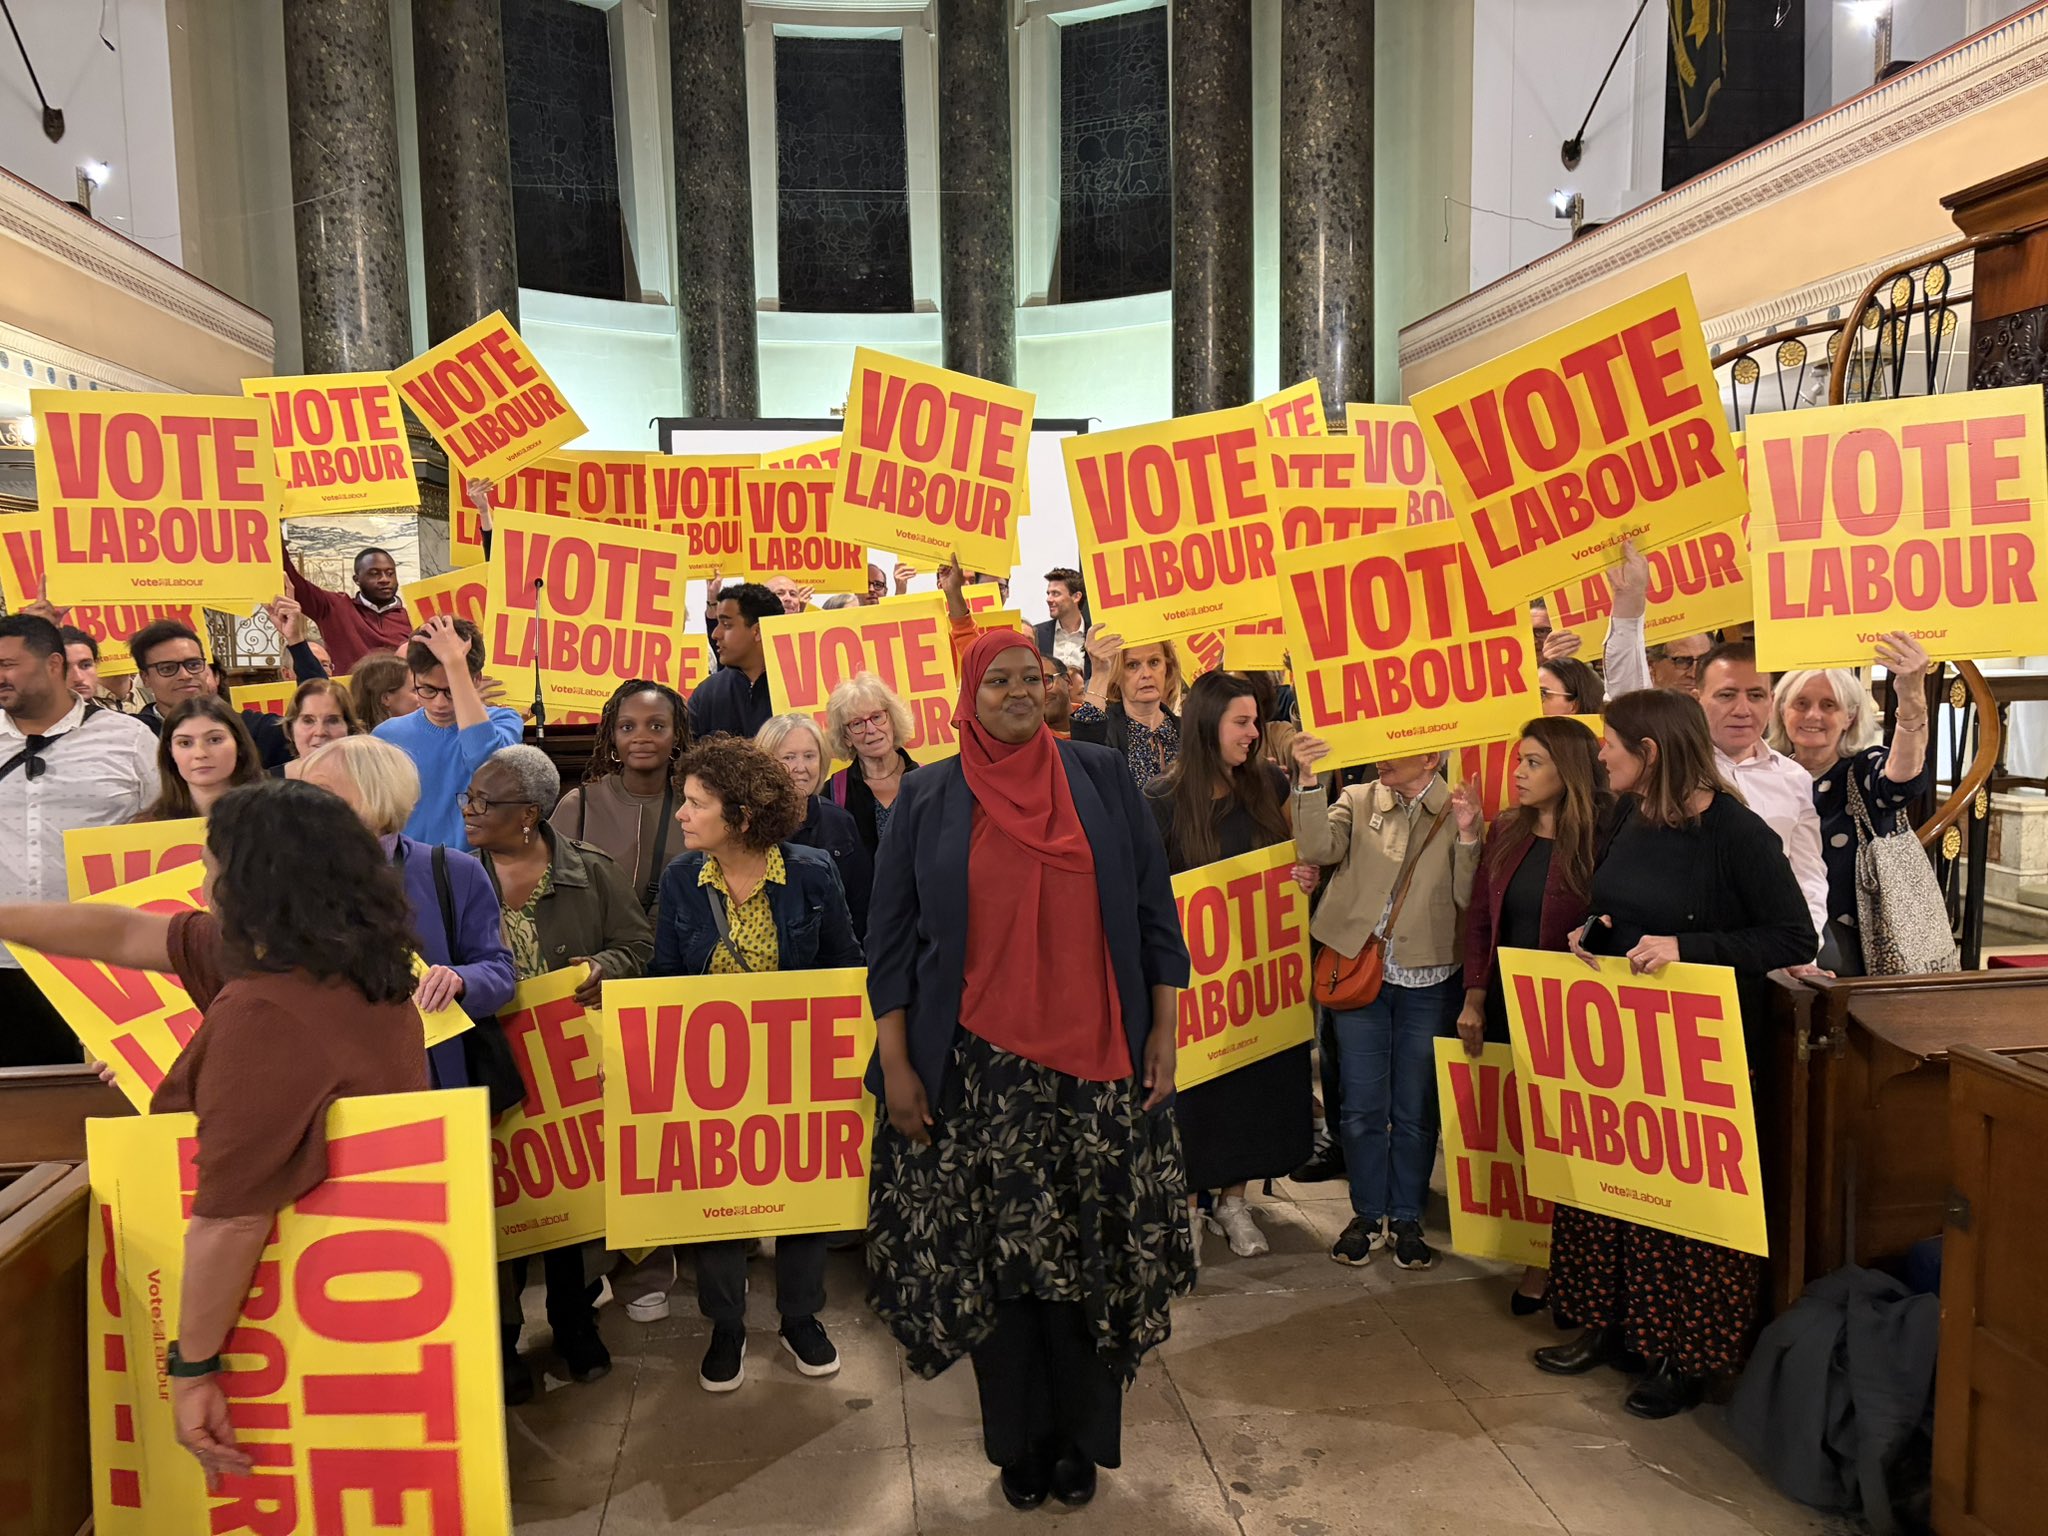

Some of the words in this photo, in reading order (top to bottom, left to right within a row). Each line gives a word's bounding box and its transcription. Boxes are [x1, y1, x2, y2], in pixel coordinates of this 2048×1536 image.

[402, 328, 539, 430] VOTE
[1433, 307, 1703, 500] VOTE
[44, 412, 265, 501] VOTE
[274, 444, 408, 488] ABOUR
[444, 383, 567, 468] LABOUR
[860, 368, 1023, 484] VOTE
[747, 482, 836, 533] VOT
[844, 452, 1011, 540] LABOUR
[1075, 427, 1267, 544] VOTE
[1471, 418, 1725, 569] LABOUR
[1763, 414, 2031, 542] VOTE
[53, 507, 272, 564] LABOUR
[504, 528, 678, 628] VOTE
[750, 536, 862, 570] LABOUR
[896, 529, 916, 540] Vote
[923, 536, 952, 548] Labour
[1092, 521, 1277, 610] LABOUR
[1572, 544, 1601, 560] Vote
[1610, 524, 1650, 545] Labour
[1767, 533, 2038, 620] LABOUR
[131, 578, 158, 587] Vote
[1163, 611, 1186, 621] Vote
[1192, 603, 1224, 616] Labour
[1553, 532, 1744, 628] LAOUR
[492, 613, 672, 683] LABOUR
[773, 618, 946, 707] VOTE
[1857, 632, 1885, 643] Vot
[1909, 628, 1948, 639] abour
[551, 685, 573, 693] Vote
[580, 687, 611, 697] Labour
[1306, 636, 1528, 728] LABOUR
[1386, 728, 1413, 740] Vote
[1422, 721, 1458, 734] Labour
[1178, 952, 1305, 1048] ABOUR
[1512, 974, 1736, 1109] VOTE
[500, 995, 602, 1119] TE
[618, 995, 863, 1115] VOTE
[491, 1109, 605, 1208] BOUR
[619, 1110, 865, 1195] LABOUR
[1528, 1082, 1749, 1196] LABOUR
[502, 1223, 528, 1236] Vote
[536, 1212, 569, 1227] Labour
[702, 1206, 734, 1218] Vote
[744, 1203, 786, 1215] Labour
[1600, 1181, 1626, 1197] Vote
[1635, 1189, 1672, 1208] Labour
[147, 1268, 163, 1319] Vote
[293, 1116, 463, 1536] VOTE
